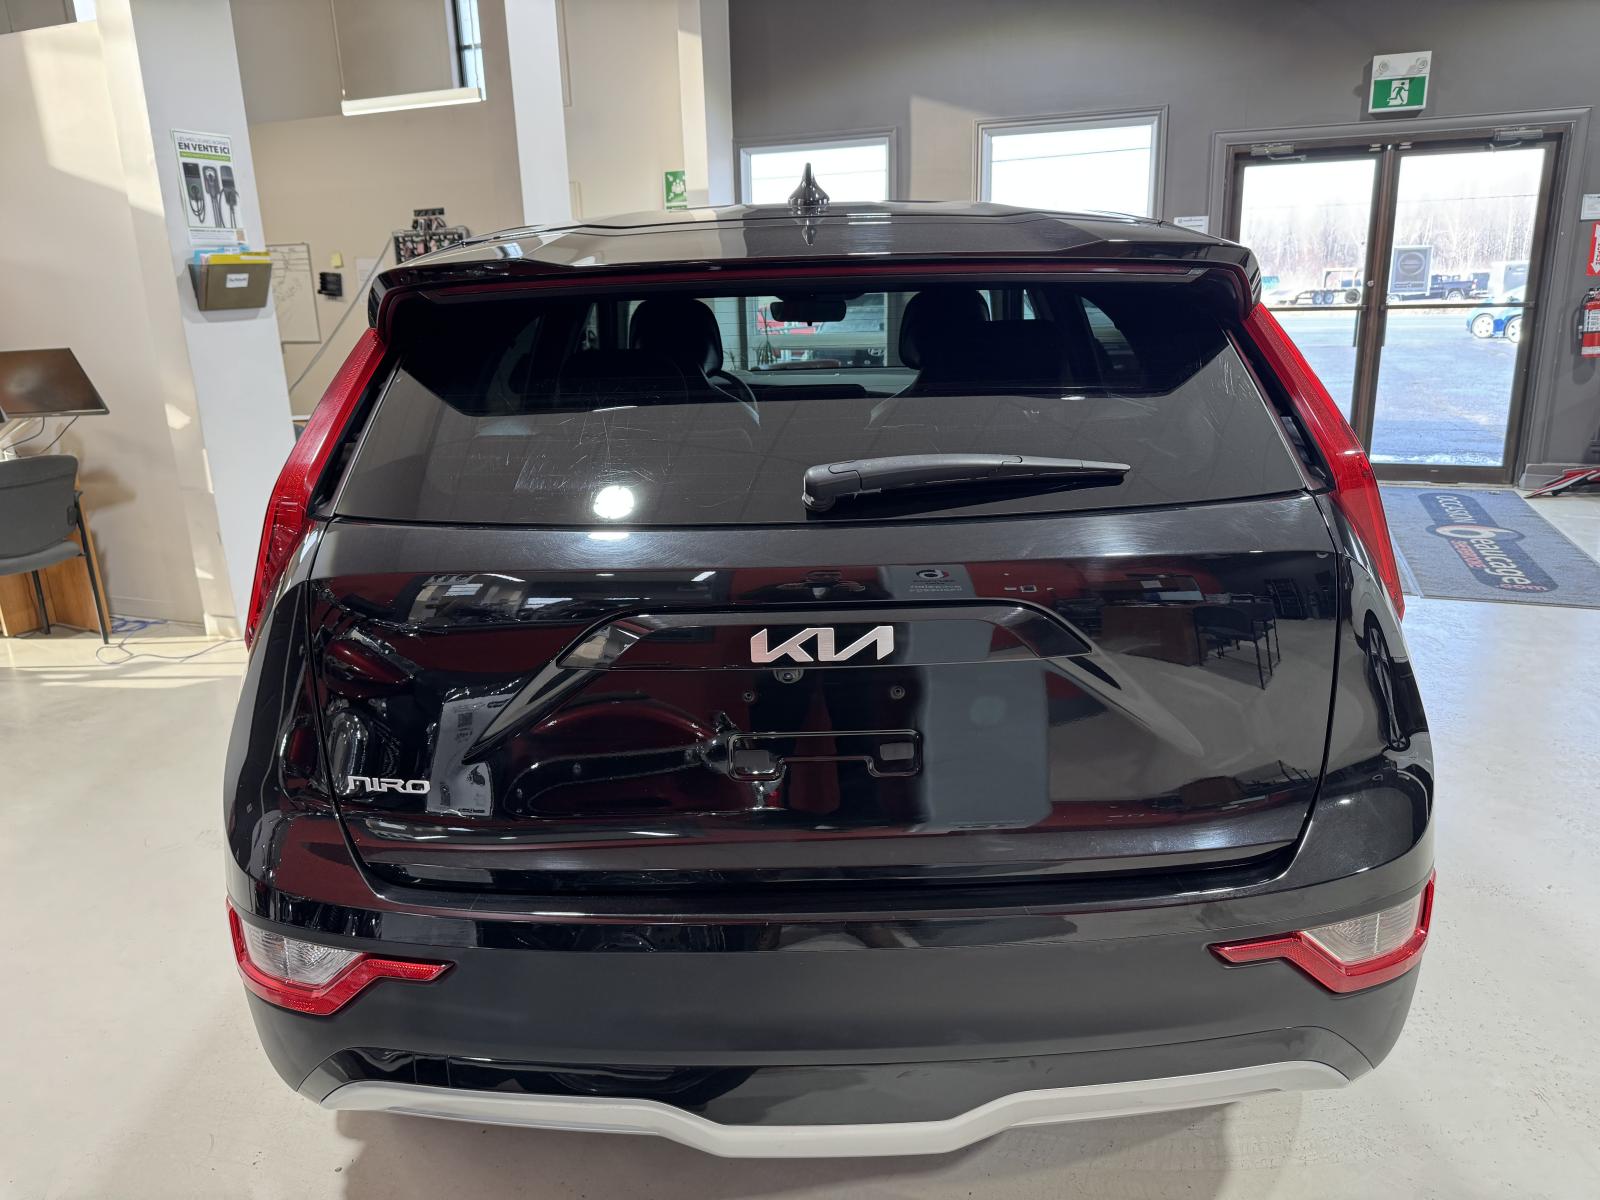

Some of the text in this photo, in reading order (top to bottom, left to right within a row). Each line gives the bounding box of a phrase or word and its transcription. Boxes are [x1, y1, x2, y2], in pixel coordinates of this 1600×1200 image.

[178, 142, 190, 151] EN
[191, 143, 219, 153] VENTE
[1435, 495, 1478, 523] OCCASION
[750, 625, 894, 663] KIA
